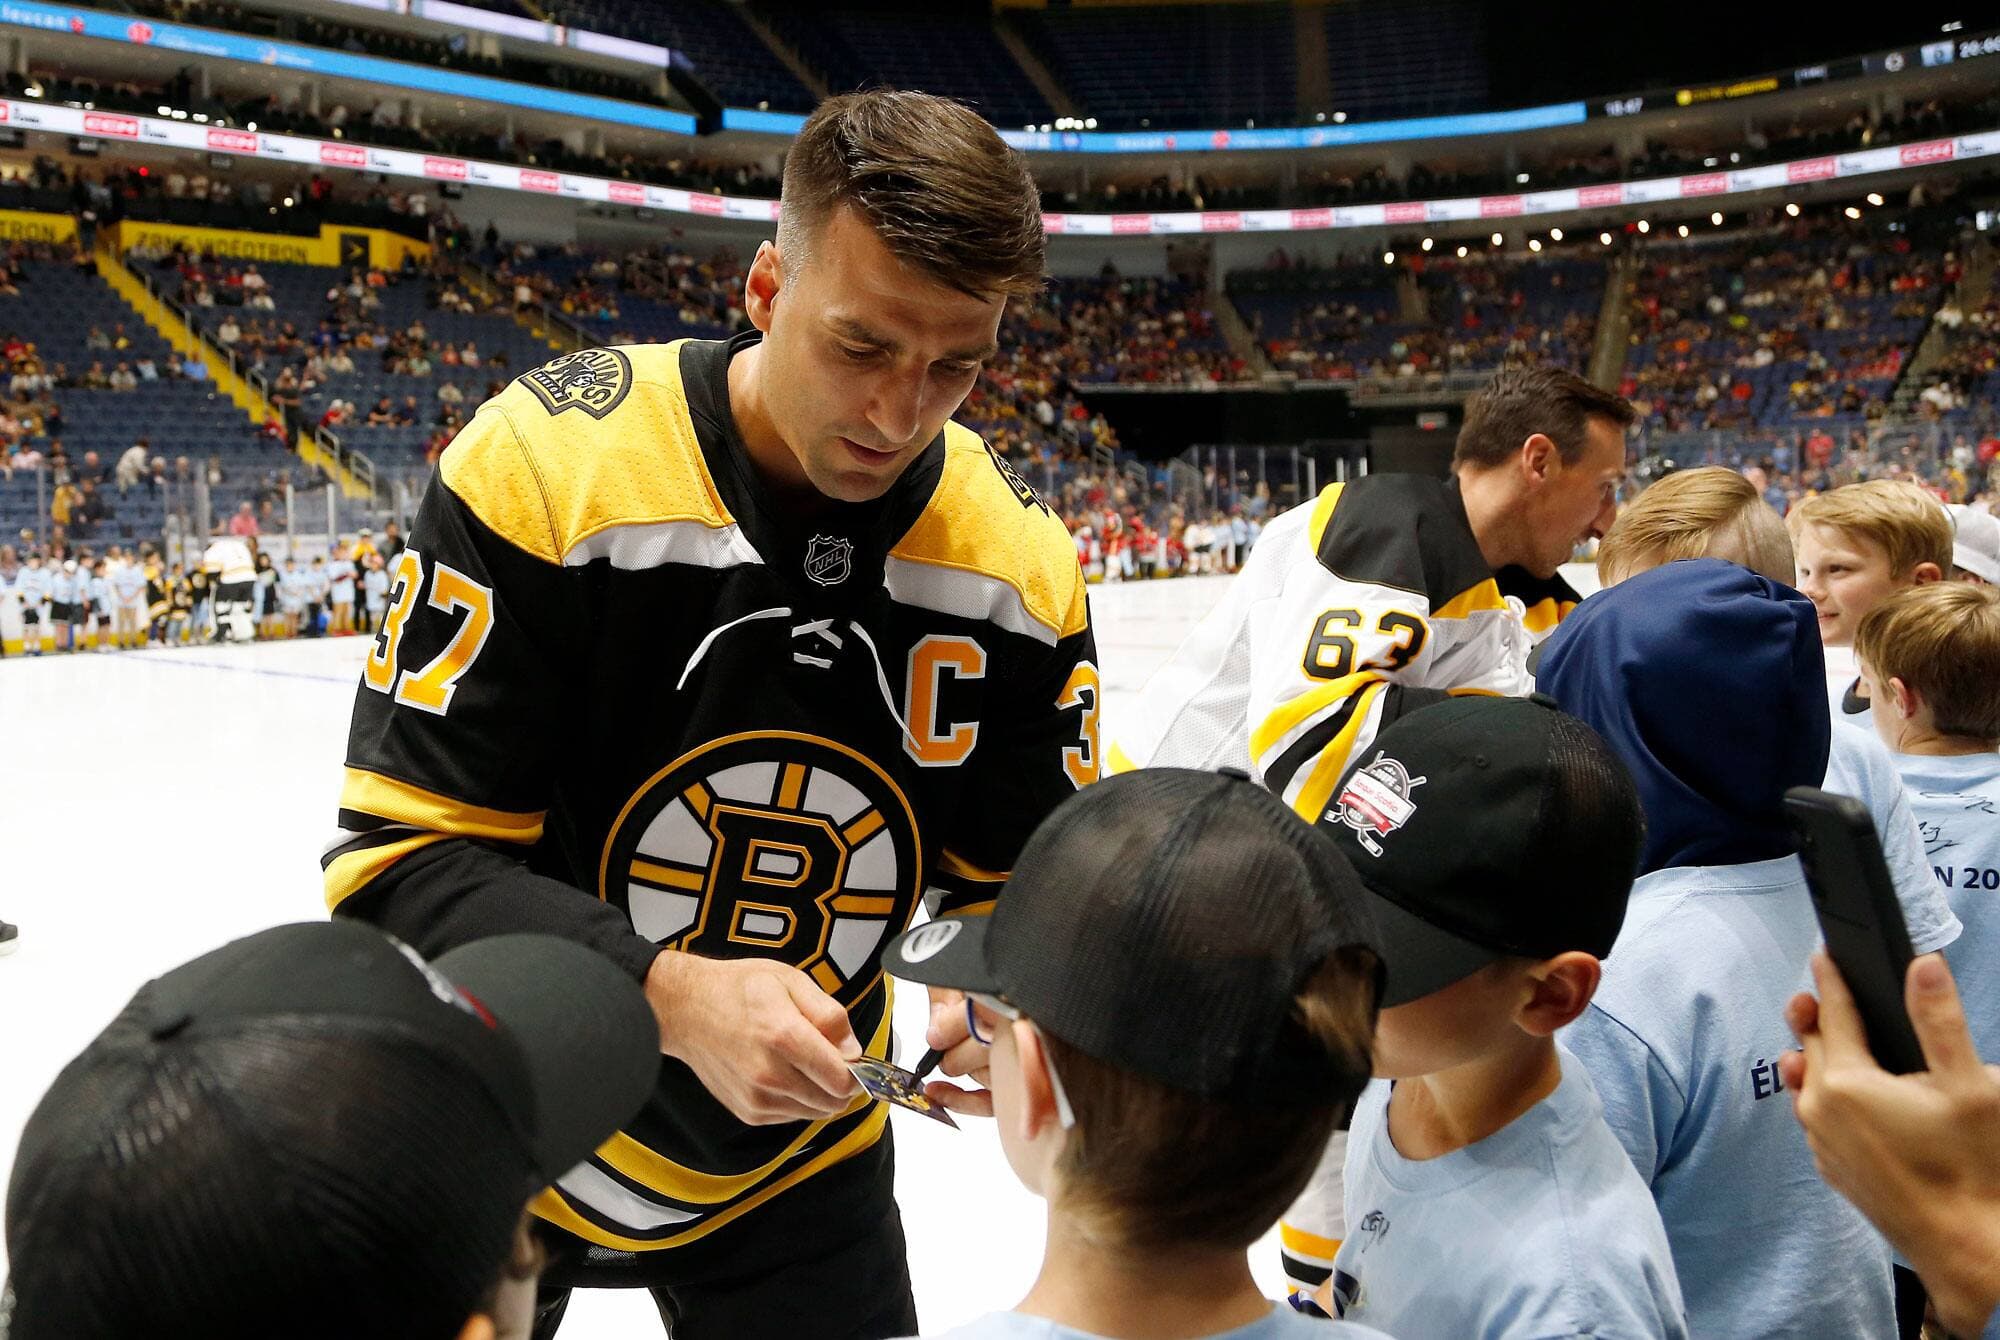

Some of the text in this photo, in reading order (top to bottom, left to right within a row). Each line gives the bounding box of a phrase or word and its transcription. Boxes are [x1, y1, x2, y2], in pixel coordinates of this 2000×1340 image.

[814, 550, 842, 573] NHL
[363, 548, 495, 716] 37
[1301, 607, 1428, 682] 63
[902, 634, 987, 767] C
[681, 803, 848, 971] B
